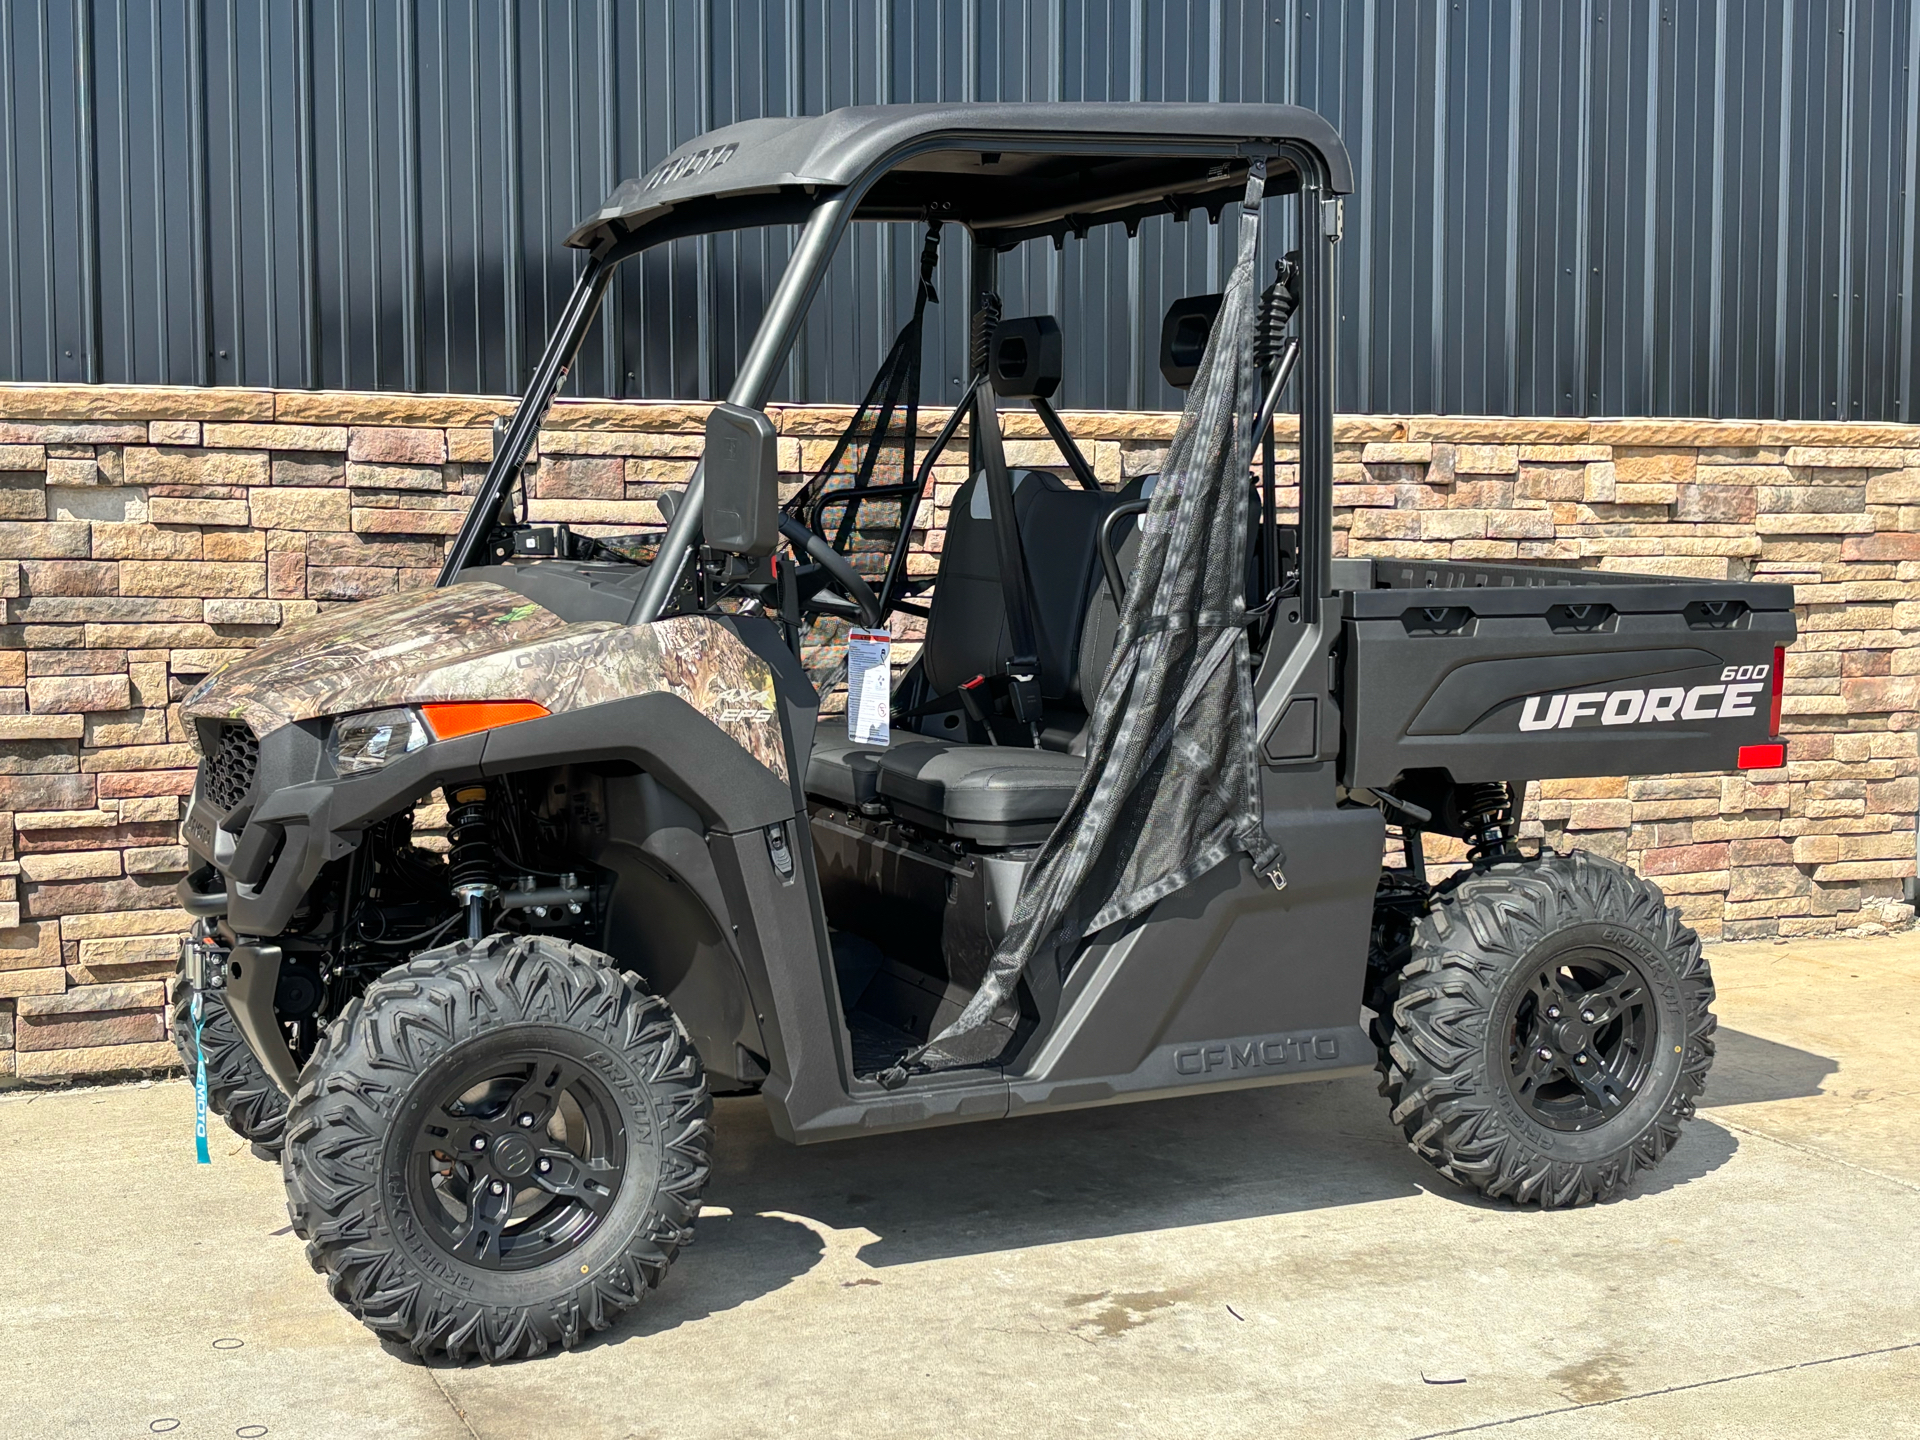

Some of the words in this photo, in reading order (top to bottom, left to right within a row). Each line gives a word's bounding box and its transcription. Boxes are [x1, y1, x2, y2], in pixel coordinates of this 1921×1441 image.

[515, 631, 635, 669] CFMOTO
[1720, 664, 1770, 681] 600
[717, 688, 771, 704] 4X4
[719, 709, 774, 723] EPS
[1519, 683, 1763, 731] UFORCE
[1601, 928, 1667, 979] BRUISER
[1174, 1034, 1340, 1076] CFMOTO
[196, 1060, 208, 1138] CFMOTO
[583, 1051, 654, 1147] ARISUN
